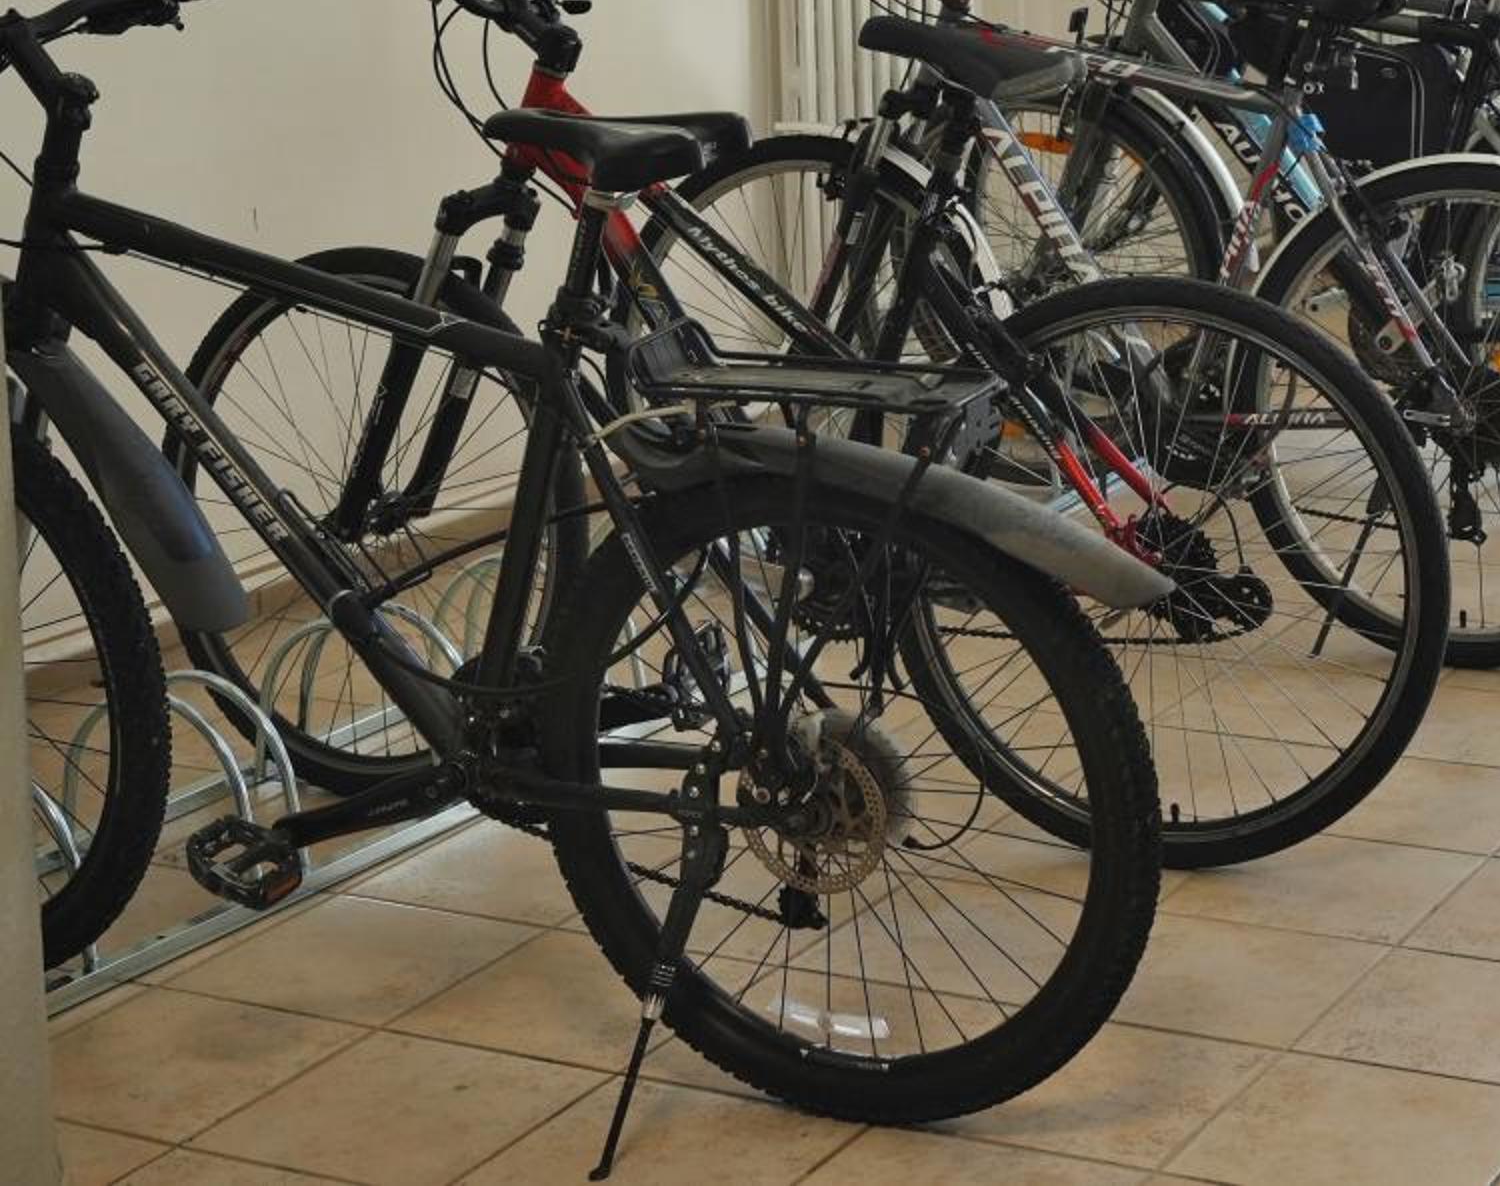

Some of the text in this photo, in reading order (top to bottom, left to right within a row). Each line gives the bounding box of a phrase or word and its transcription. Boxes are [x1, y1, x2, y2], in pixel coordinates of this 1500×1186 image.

[977, 127, 1101, 283] ALPINA
[1215, 121, 1305, 223] AUHO
[132, 362, 289, 542] GARY FISHER
